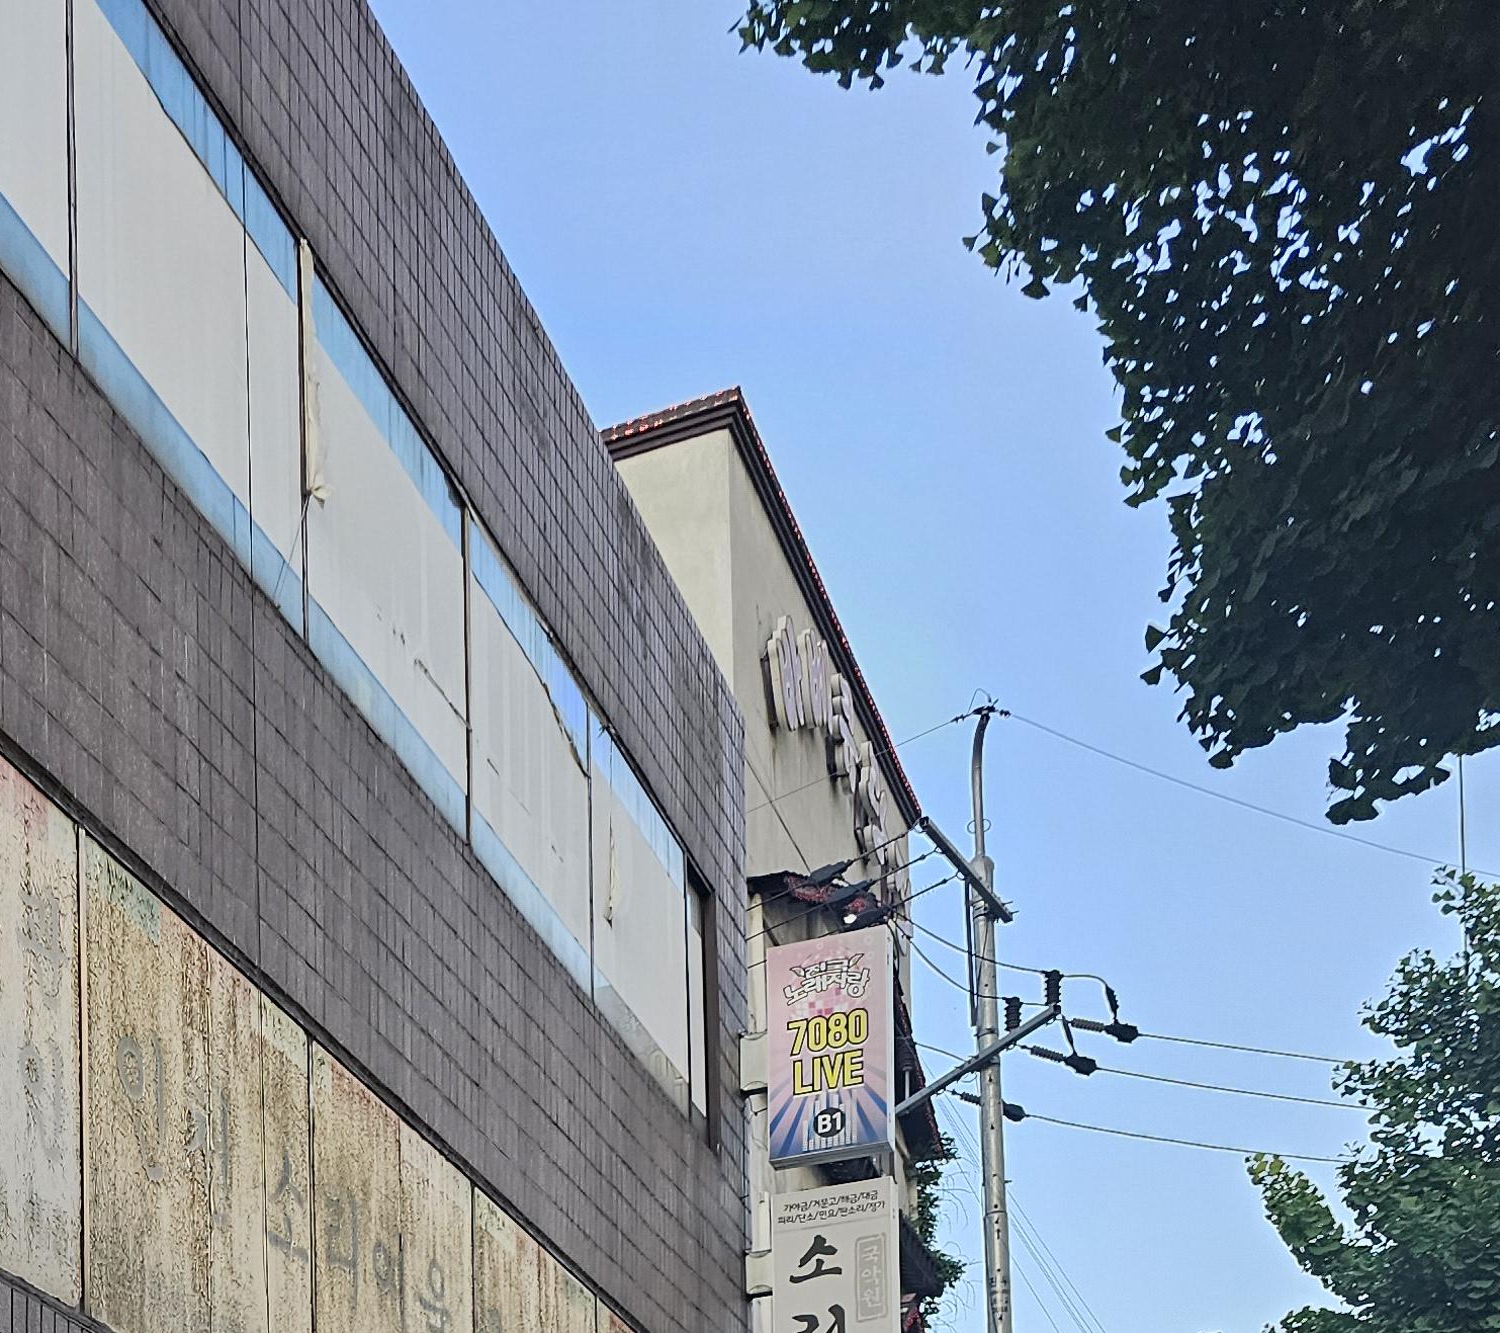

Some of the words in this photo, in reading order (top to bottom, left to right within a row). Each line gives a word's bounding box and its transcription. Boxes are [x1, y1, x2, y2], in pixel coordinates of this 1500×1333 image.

[783, 968, 870, 1006] 노래자랑
[787, 1008, 868, 1056] 7080
[793, 1050, 864, 1096] LIVE
[817, 1112, 842, 1134] B1
